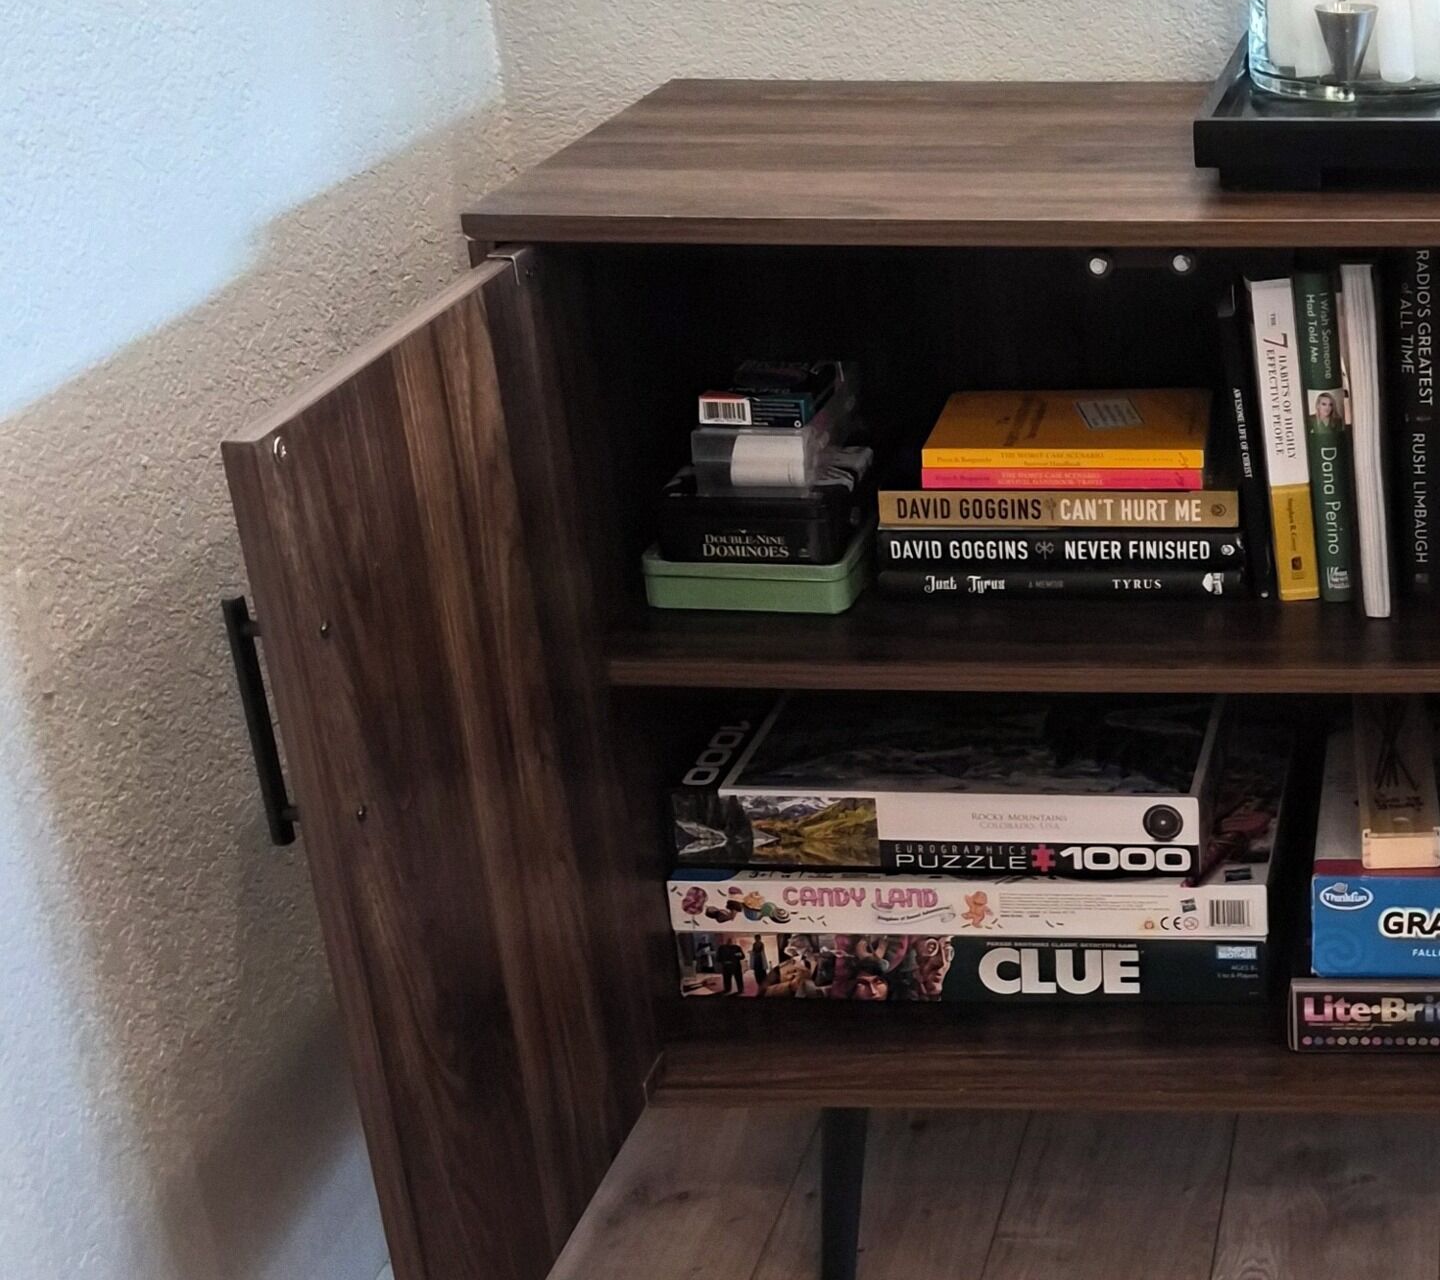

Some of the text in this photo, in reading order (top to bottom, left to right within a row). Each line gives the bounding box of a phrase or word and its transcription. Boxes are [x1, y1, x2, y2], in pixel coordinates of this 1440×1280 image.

[1306, 294, 1316, 317] Had
[1319, 299, 1330, 326] Wish
[1399, 301, 1413, 329] ALL
[1264, 333, 1288, 349] 7
[1308, 321, 1318, 344] Told
[1416, 250, 1432, 406] RADIO'S GREATEST
[1322, 329, 1333, 379] Someone
[1400, 336, 1414, 374] TIME
[1278, 355, 1291, 397] HABITS
[1266, 349, 1284, 455] EFFECTIVE PEOPLE
[1282, 401, 1291, 414] OF
[1233, 388, 1252, 478] AWESOME LIFE OF CHRIST
[1284, 418, 1296, 460] HIGHLY
[897, 498, 1202, 522] DAVID GOGGINS CAN'T HURT ME
[1320, 447, 1343, 554] Dana Perino
[1412, 433, 1428, 563] RUSH LIMBAUGH
[702, 544, 790, 558] DOMINOES
[890, 541, 1210, 560] DAVID GOGGINS NEVER FINISHED
[924, 576, 957, 593] Just
[967, 576, 1005, 594] Tyrus
[1113, 579, 1162, 589] TYRUS
[971, 812, 1068, 822] ROCKY MOUNTAINS
[895, 843, 1027, 856] EUROGRAPHICS
[896, 846, 1192, 872] PUZZLE 1000
[782, 887, 938, 909] CANDY LAND
[980, 947, 1141, 994] CLUE
